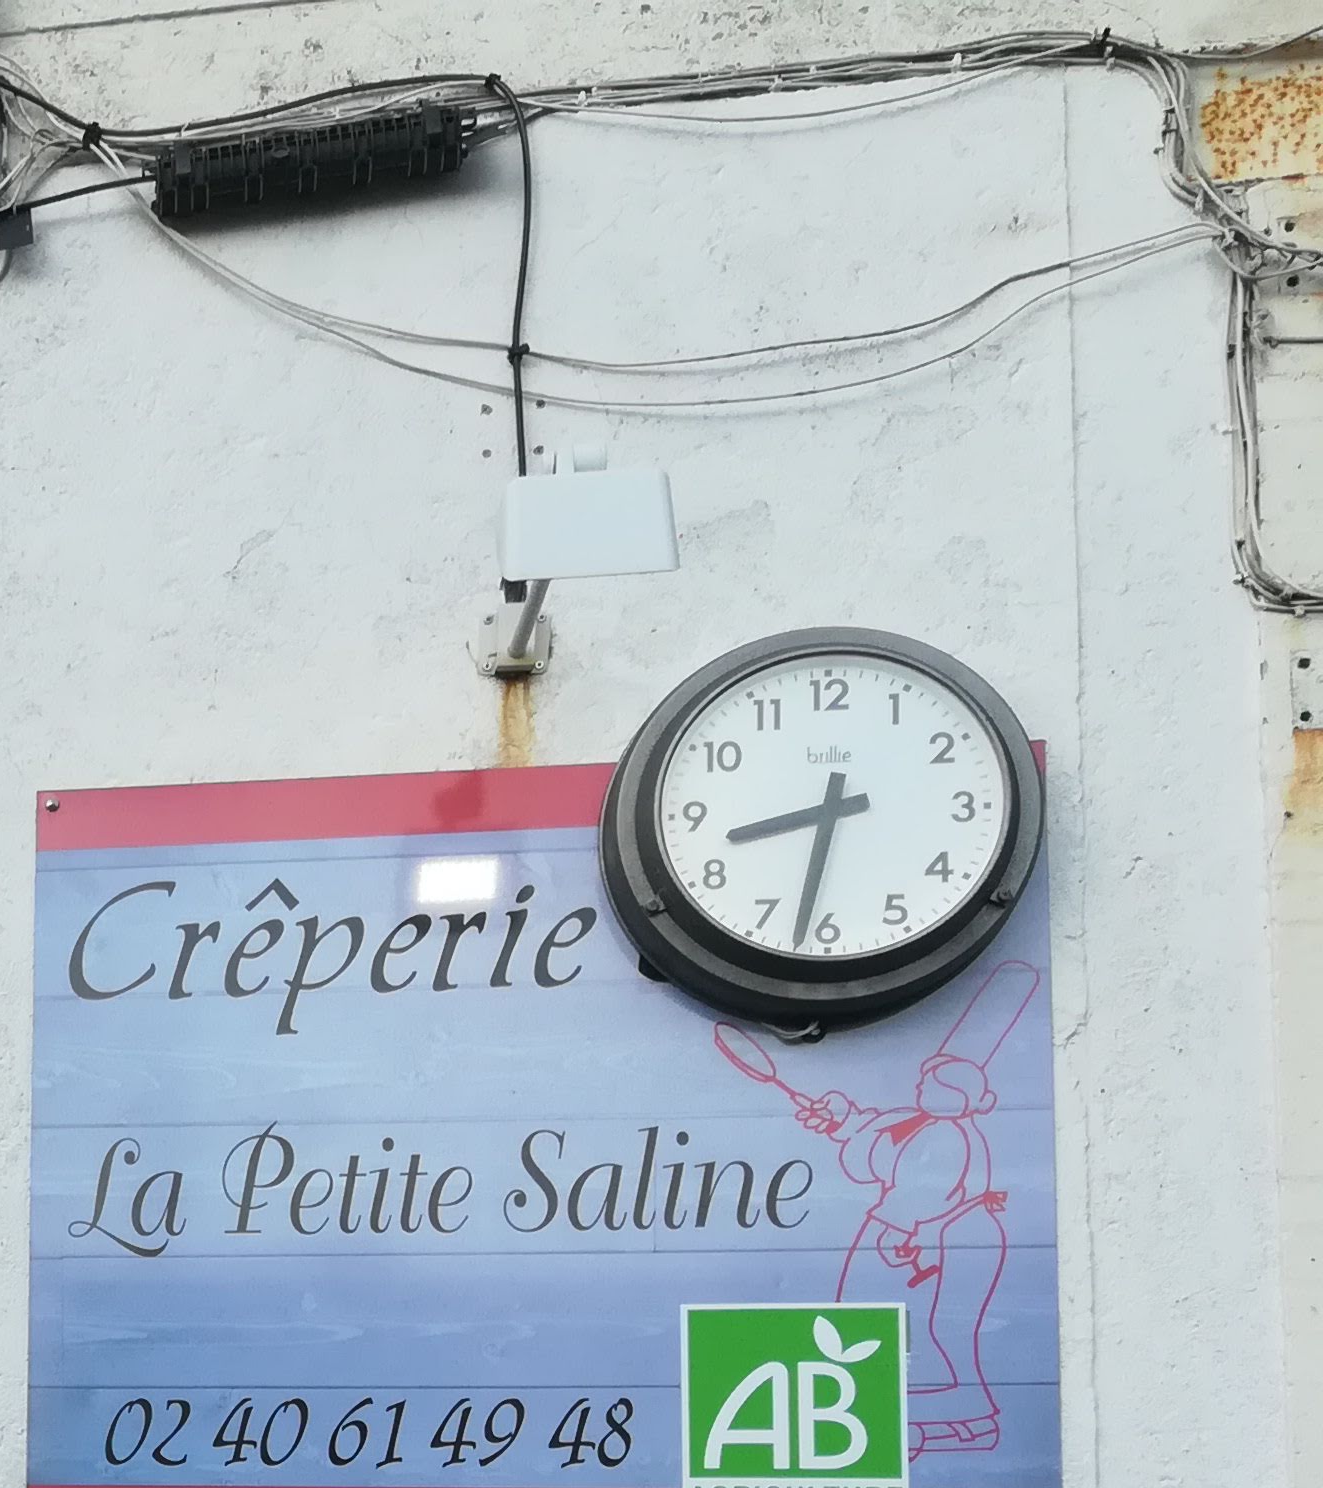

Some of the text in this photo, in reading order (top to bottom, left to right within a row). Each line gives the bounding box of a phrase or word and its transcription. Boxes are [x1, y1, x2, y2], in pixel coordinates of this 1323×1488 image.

[809, 678, 850, 712] 12
[888, 693, 900, 725] 1
[753, 698, 782, 731] 11
[703, 741, 742, 773] 10
[929, 732, 955, 764] 2
[682, 801, 708, 833] 9
[950, 791, 976, 823] 3
[702, 859, 727, 890] 8
[924, 851, 954, 883] 4
[755, 898, 782, 929] 7
[882, 893, 908, 926] 5
[814, 913, 841, 944] 6
[67, 877, 598, 1035] Crêperie
[67, 1120, 813, 1258] La Petite Saline
[704, 1361, 868, 1470] AB
[104, 1397, 634, 1469] 02 40 61 49 48
